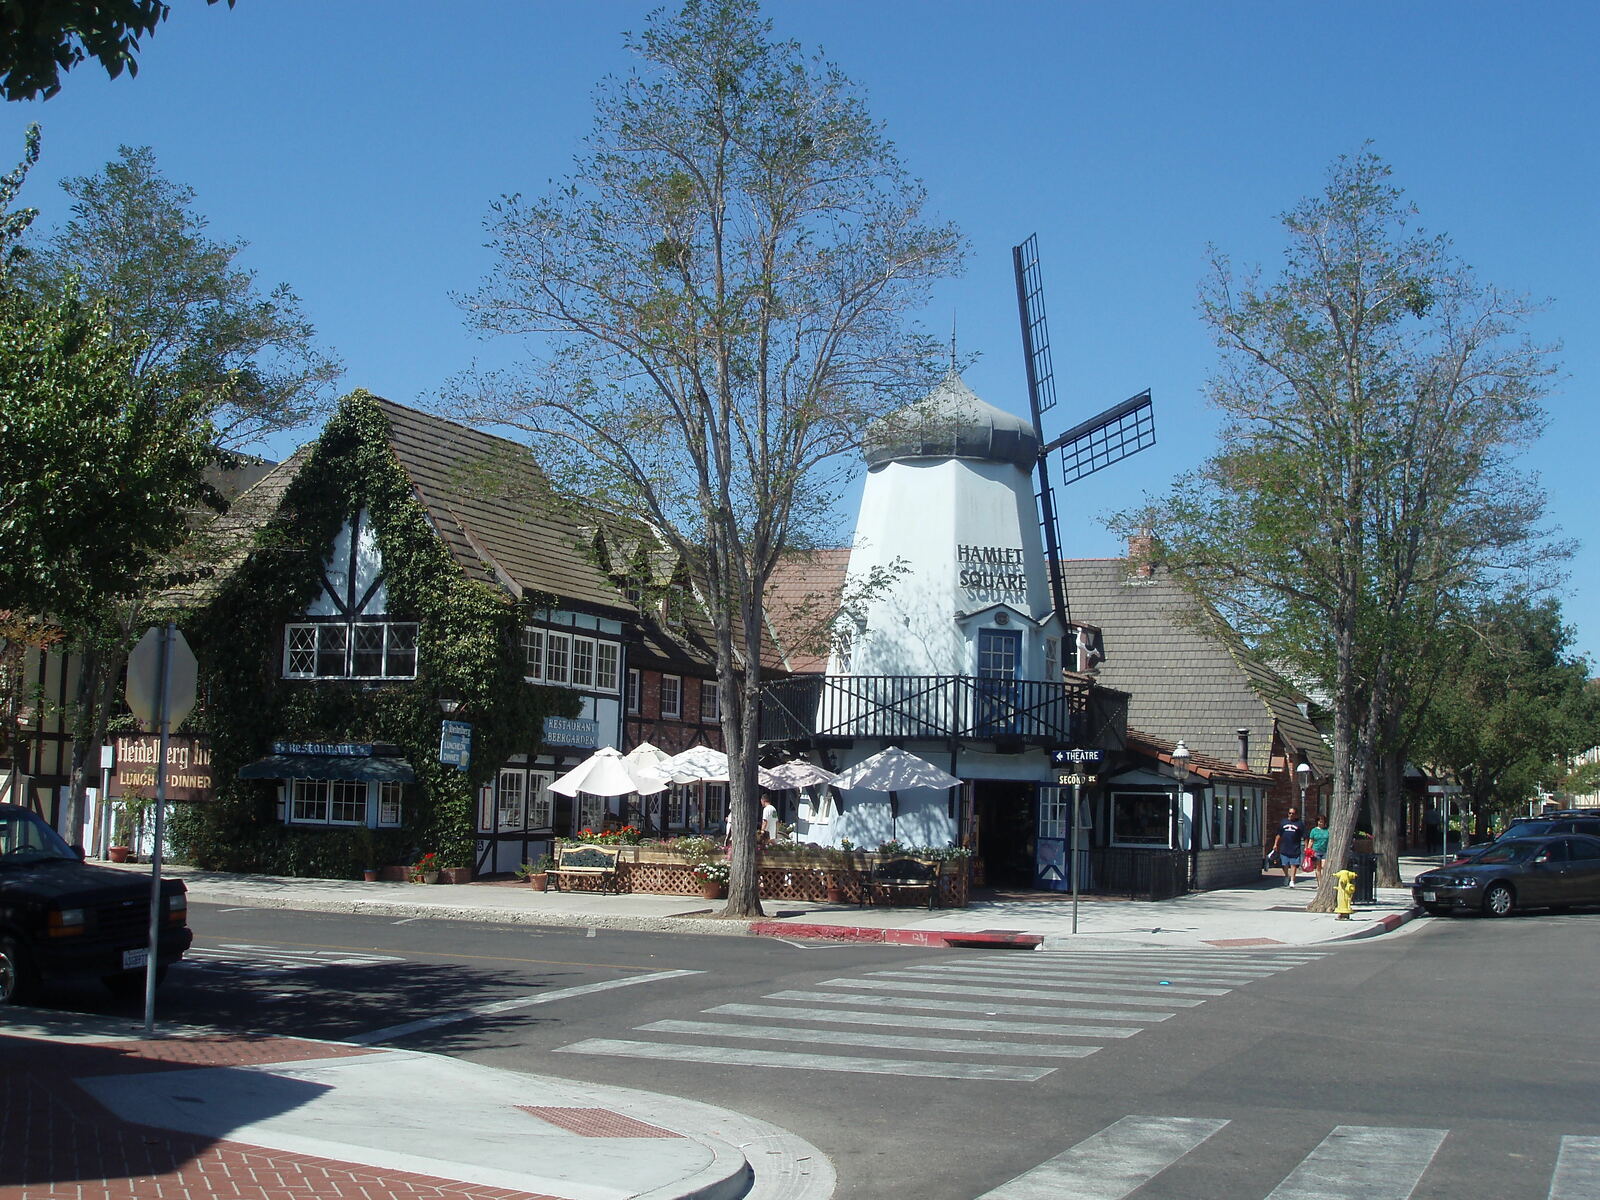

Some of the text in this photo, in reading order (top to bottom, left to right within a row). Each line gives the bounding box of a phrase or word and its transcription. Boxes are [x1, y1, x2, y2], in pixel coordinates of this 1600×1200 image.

[957, 544, 1024, 564] HAMLET
[959, 570, 1027, 590] SQUARE
[548, 719, 595, 732] RESTAURANT
[547, 732, 595, 745] BEERGARDEN
[289, 742, 355, 755] Restaurant
[1065, 751, 1099, 760] THEATRE
[120, 771, 155, 786] LUNCH
[171, 774, 212, 789] DINNER
[1059, 775, 1086, 784] SECOND
